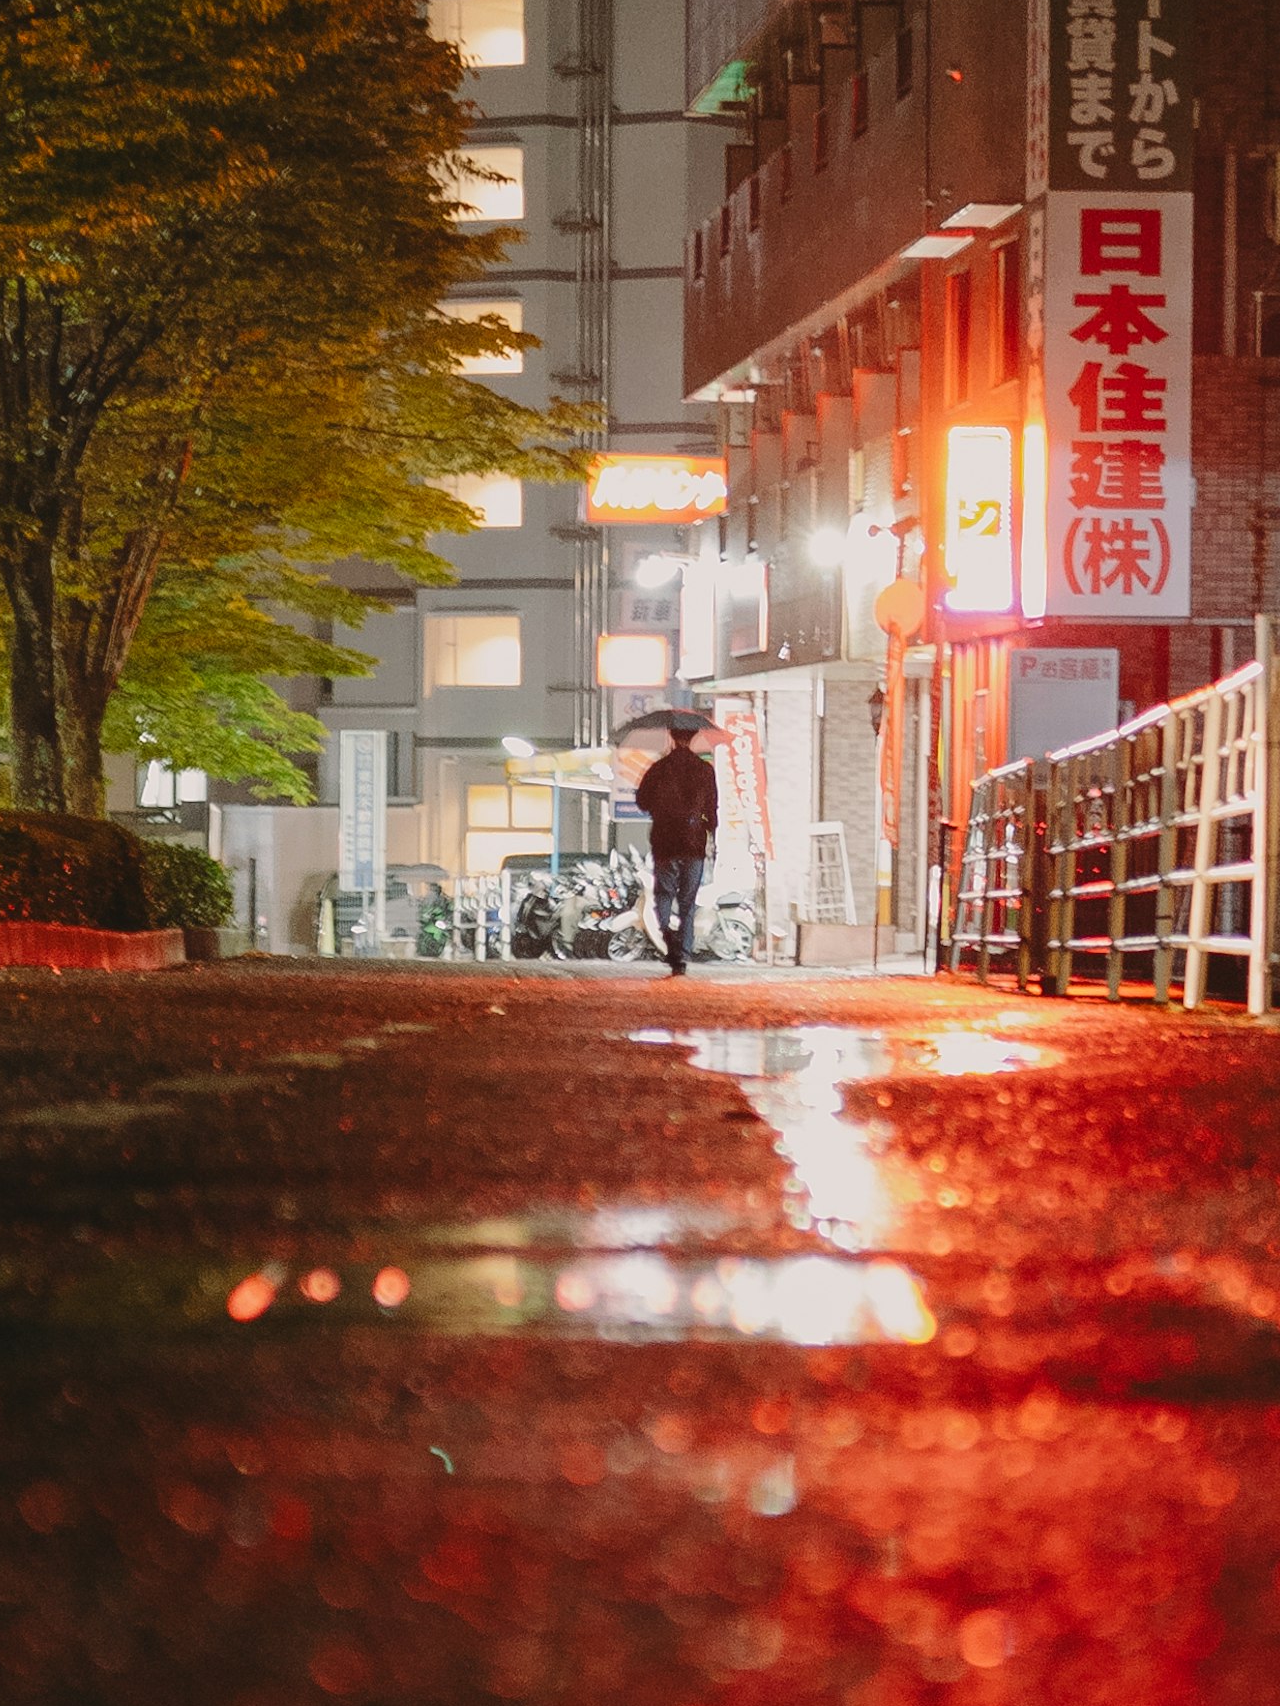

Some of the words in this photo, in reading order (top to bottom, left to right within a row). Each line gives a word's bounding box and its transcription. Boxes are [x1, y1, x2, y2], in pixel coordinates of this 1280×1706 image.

[1062, 209, 1171, 596] 日本住建(株)
